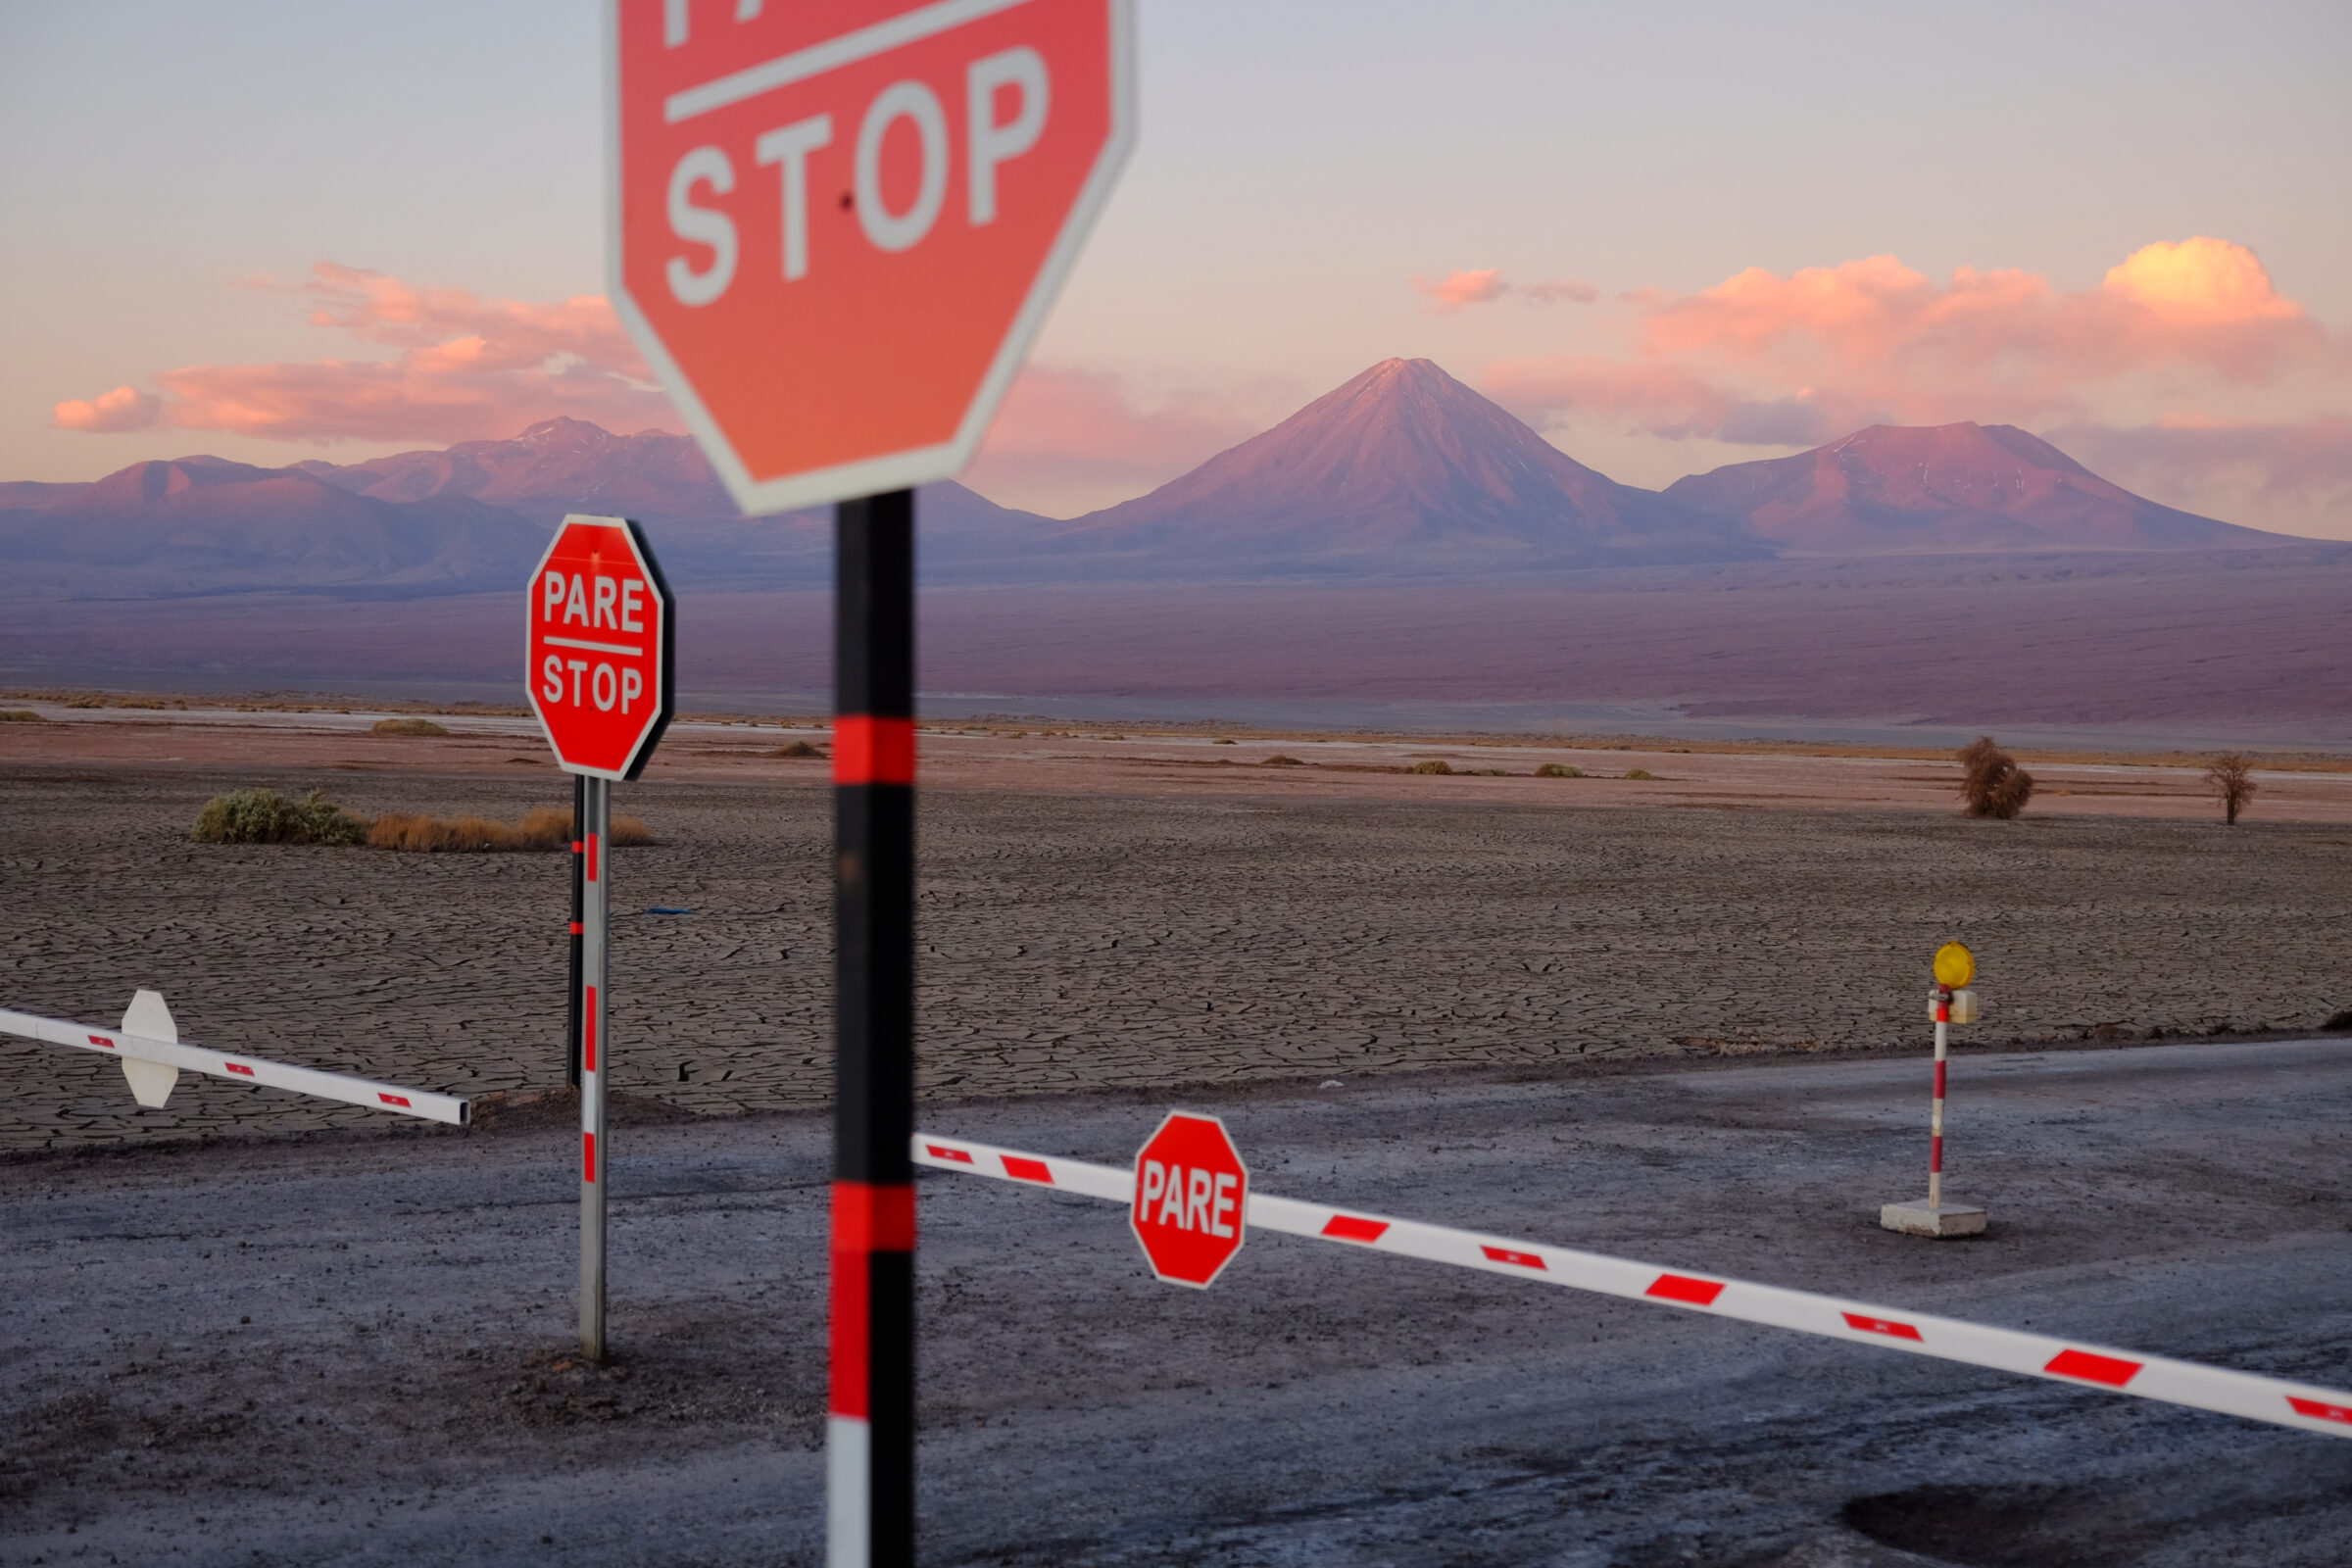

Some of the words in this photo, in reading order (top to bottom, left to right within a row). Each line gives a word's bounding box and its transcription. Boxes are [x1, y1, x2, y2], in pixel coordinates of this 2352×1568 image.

[664, 45, 1051, 308] STOP
[543, 570, 645, 634] PARE
[542, 654, 643, 715] STOP
[1140, 1158, 1238, 1240] PARE
